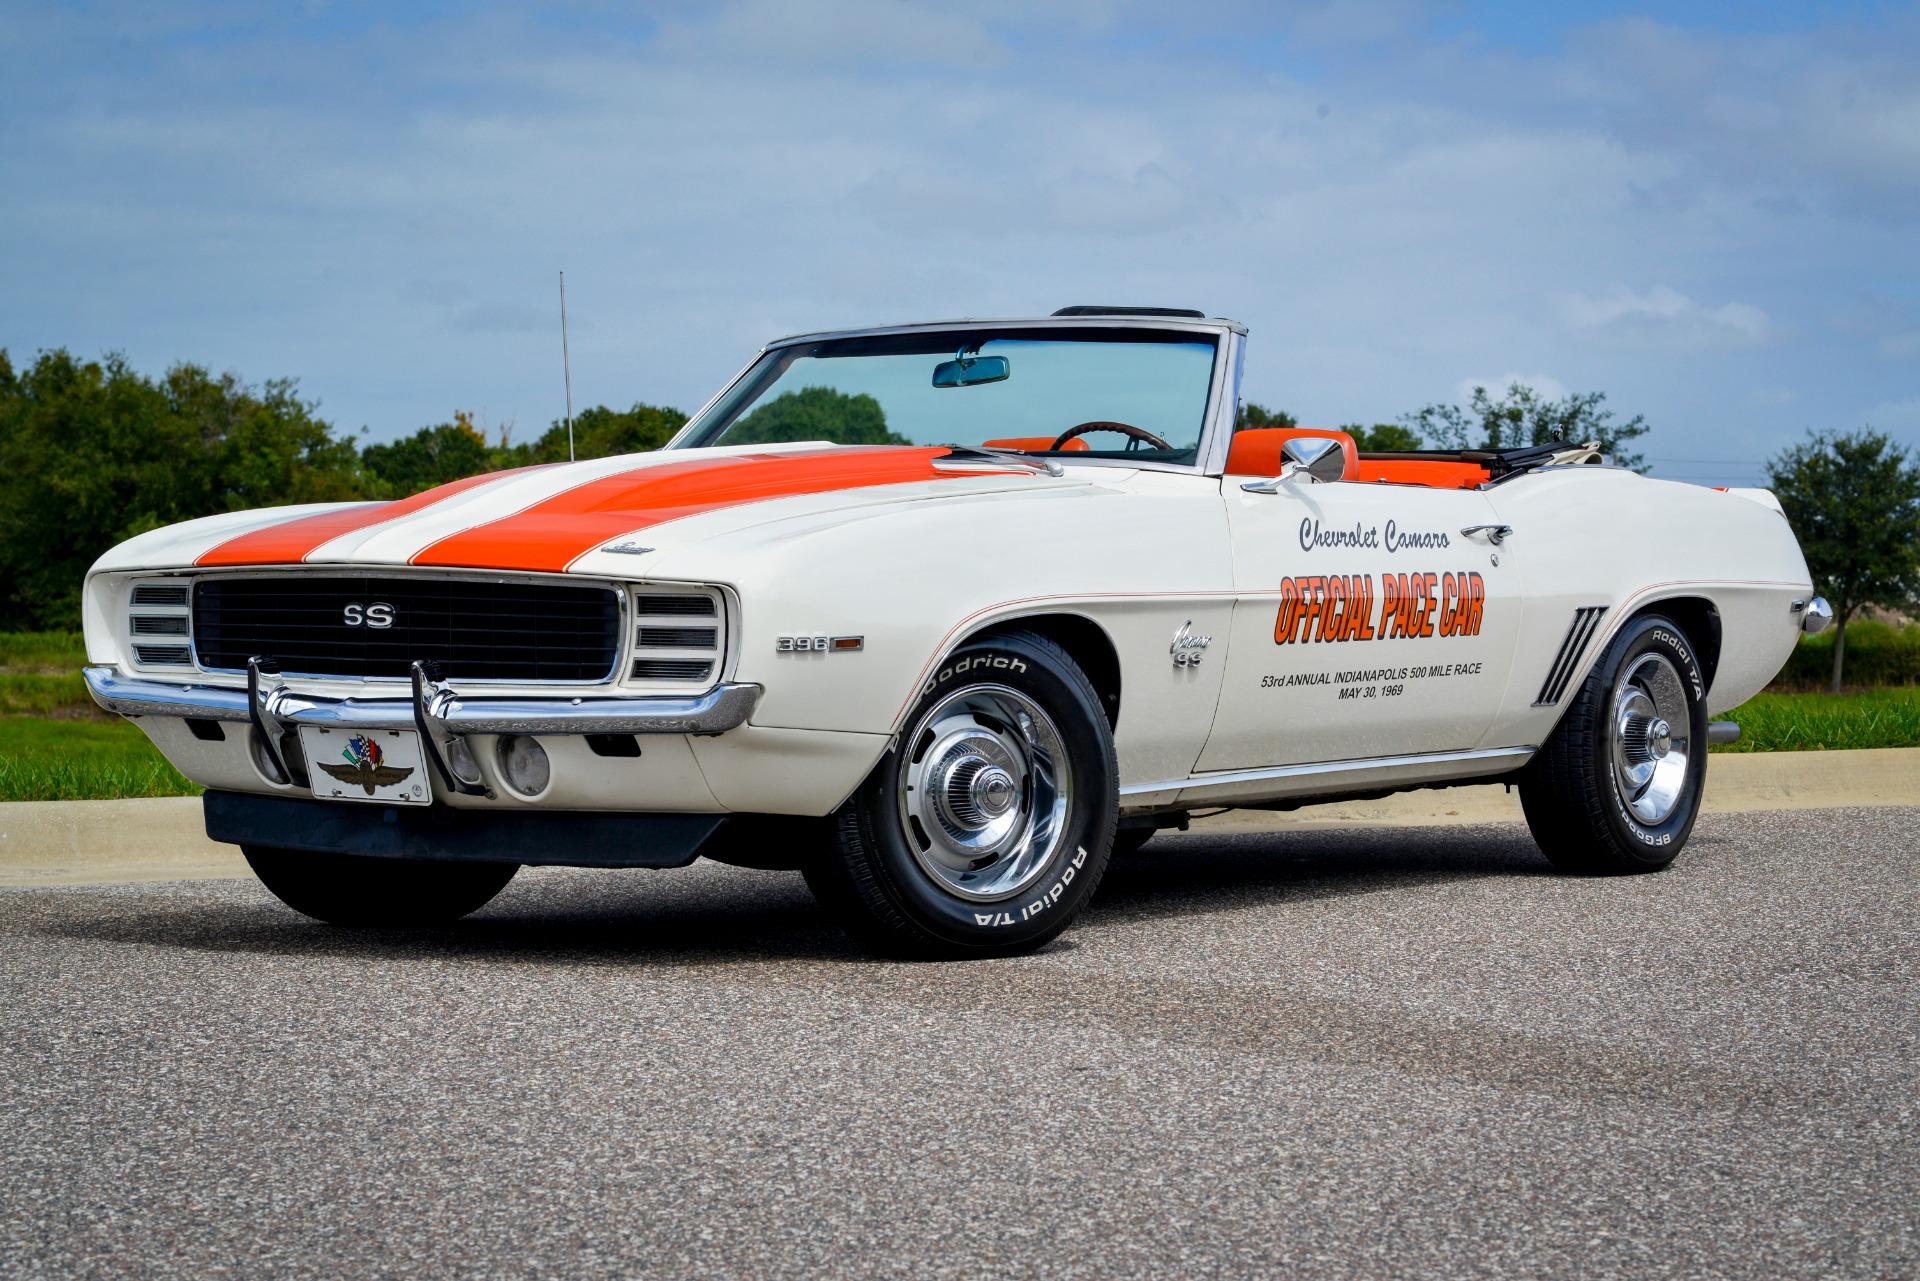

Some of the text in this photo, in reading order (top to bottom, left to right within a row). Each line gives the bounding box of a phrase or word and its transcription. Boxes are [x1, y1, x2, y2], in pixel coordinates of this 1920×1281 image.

[1299, 517, 1450, 553] Chevrolet Camaro
[344, 602, 395, 628] SS
[1274, 571, 1485, 645] OFFICIAL PACE CAR
[776, 636, 828, 652] 396
[1173, 651, 1203, 668] SS
[1652, 630, 1702, 702] Radial T/A
[1260, 662, 1482, 688] 53rd ANNUAL INDIANAPOLIS 500 MILE RACE
[1338, 684, 1404, 700] MAY 30, 1969
[974, 845, 1088, 927] Radial T/A
